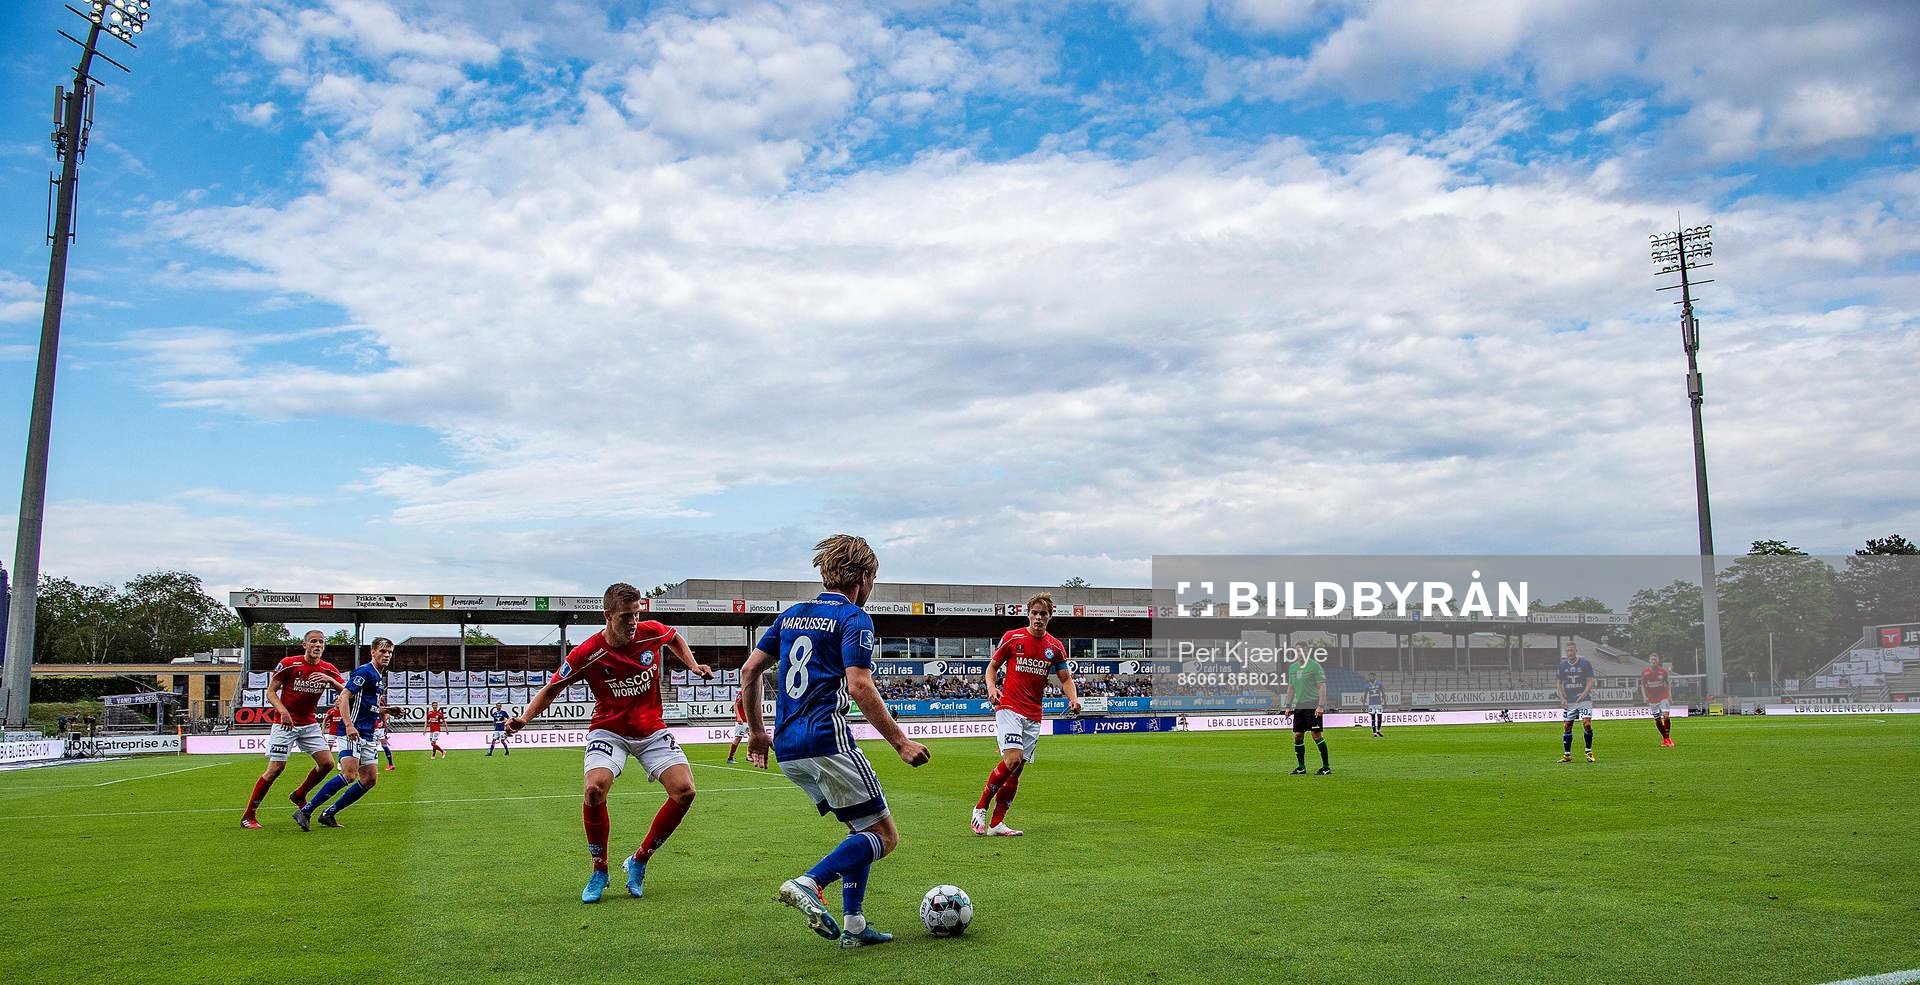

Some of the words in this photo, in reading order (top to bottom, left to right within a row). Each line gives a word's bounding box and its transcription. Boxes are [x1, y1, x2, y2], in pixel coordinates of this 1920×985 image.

[894, 604, 911, 612] Dahl
[1007, 604, 1022, 615] 3F
[781, 616, 837, 632] MARCUSSEN
[1904, 631, 1920, 642] JE
[785, 635, 813, 699] 8
[1016, 657, 1049, 669] MASCOT
[1079, 664, 1095, 673] carl
[1203, 663, 1218, 673] carl
[878, 664, 896, 674] carl
[898, 666, 913, 674] ras
[948, 664, 965, 674] carl
[967, 666, 982, 674] ras
[608, 667, 654, 690] MASCOT
[244, 693, 261, 704] help
[1435, 692, 1485, 702] OLÆGNING
[1490, 690, 1529, 701] SJÆLLAND
[941, 702, 955, 710] carl
[1795, 704, 1894, 713] LBK.BLUEENERGY.DK
[907, 724, 999, 735] LBK.BLUEENERG
[1095, 721, 1137, 732] LYNGBY
[162, 739, 180, 748] A/S
